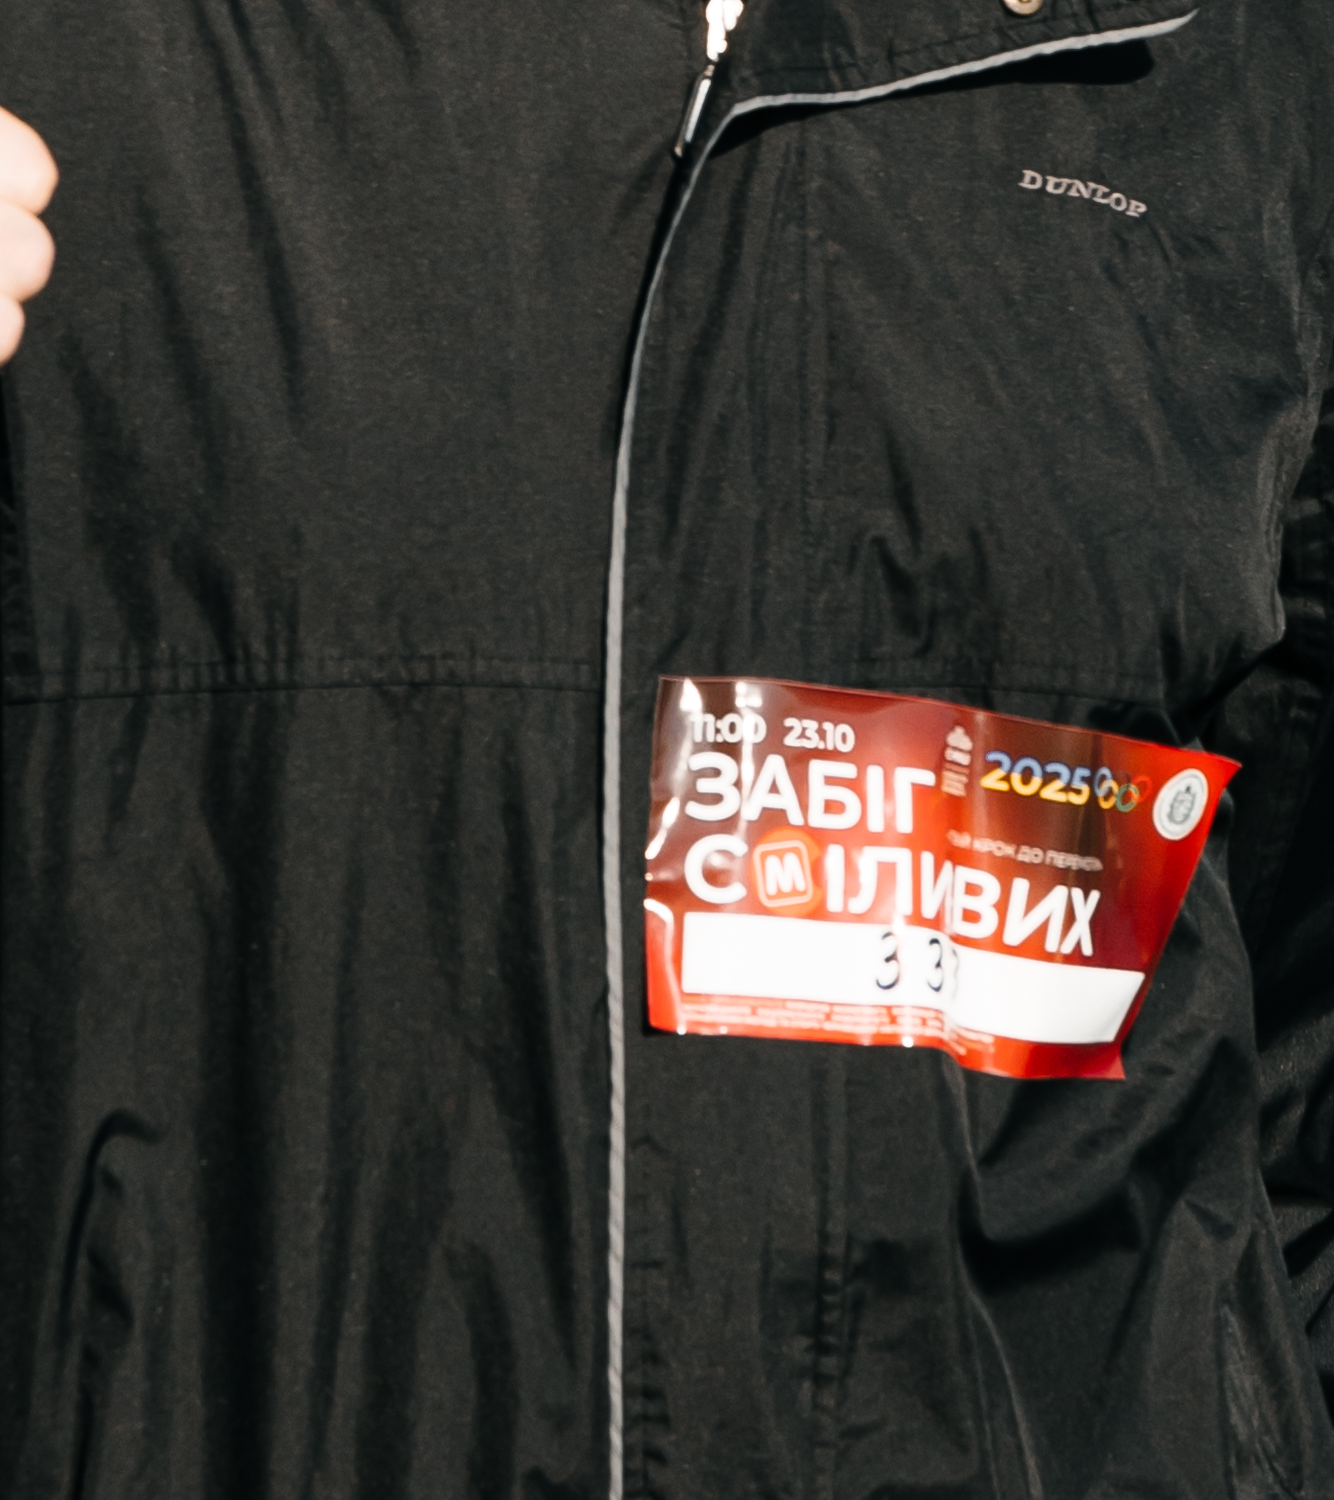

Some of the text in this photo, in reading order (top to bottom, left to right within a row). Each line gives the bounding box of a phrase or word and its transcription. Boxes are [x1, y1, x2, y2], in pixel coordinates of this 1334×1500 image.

[1018, 168, 1148, 218] DUNLOP
[690, 712, 856, 753] 11:00 23.10
[684, 751, 937, 834] ЗАБІГ
[979, 750, 1091, 806] 2025
